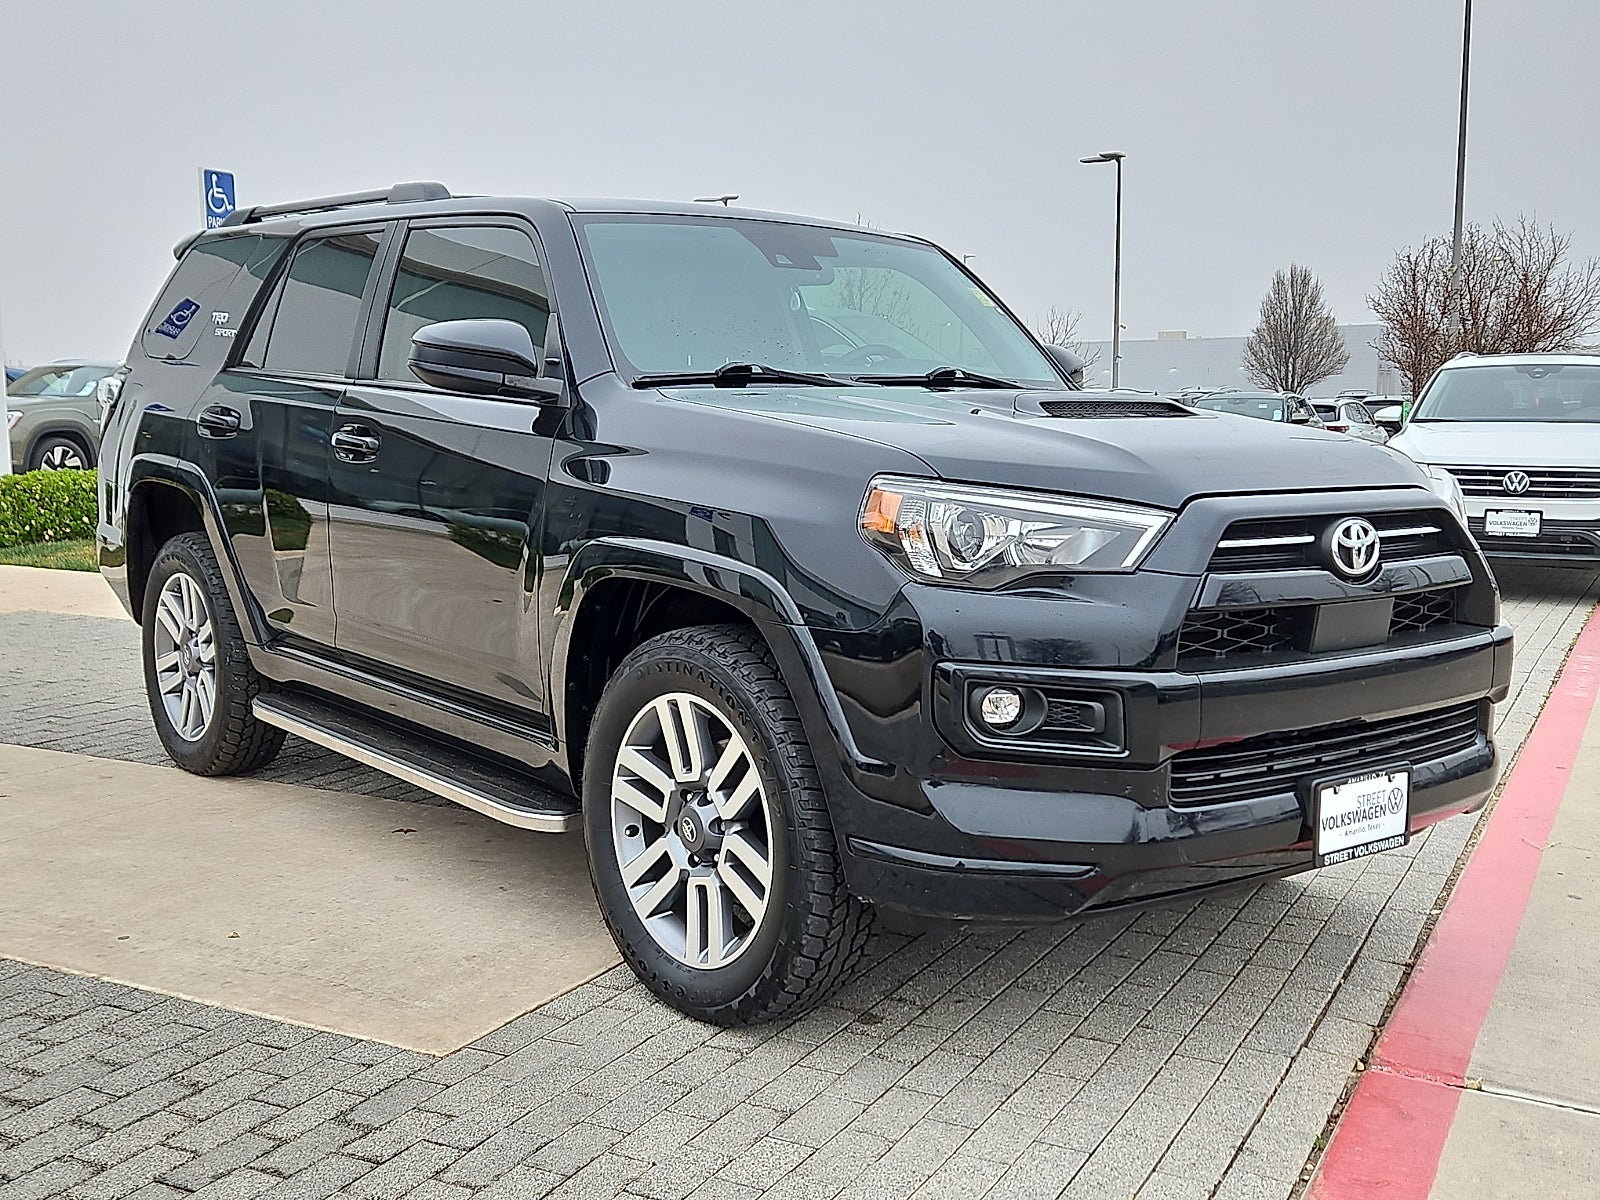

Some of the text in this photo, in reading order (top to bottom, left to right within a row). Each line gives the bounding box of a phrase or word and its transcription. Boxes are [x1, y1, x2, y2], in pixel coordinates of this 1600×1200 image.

[211, 311, 230, 325] TRD
[214, 327, 238, 338] SPORT
[636, 659, 750, 727] DESTINATION
[1356, 789, 1387, 809] STREET
[1321, 804, 1387, 831] VOLKSWAGEN
[1324, 835, 1404, 865] STREET VOLKSWAGEN
